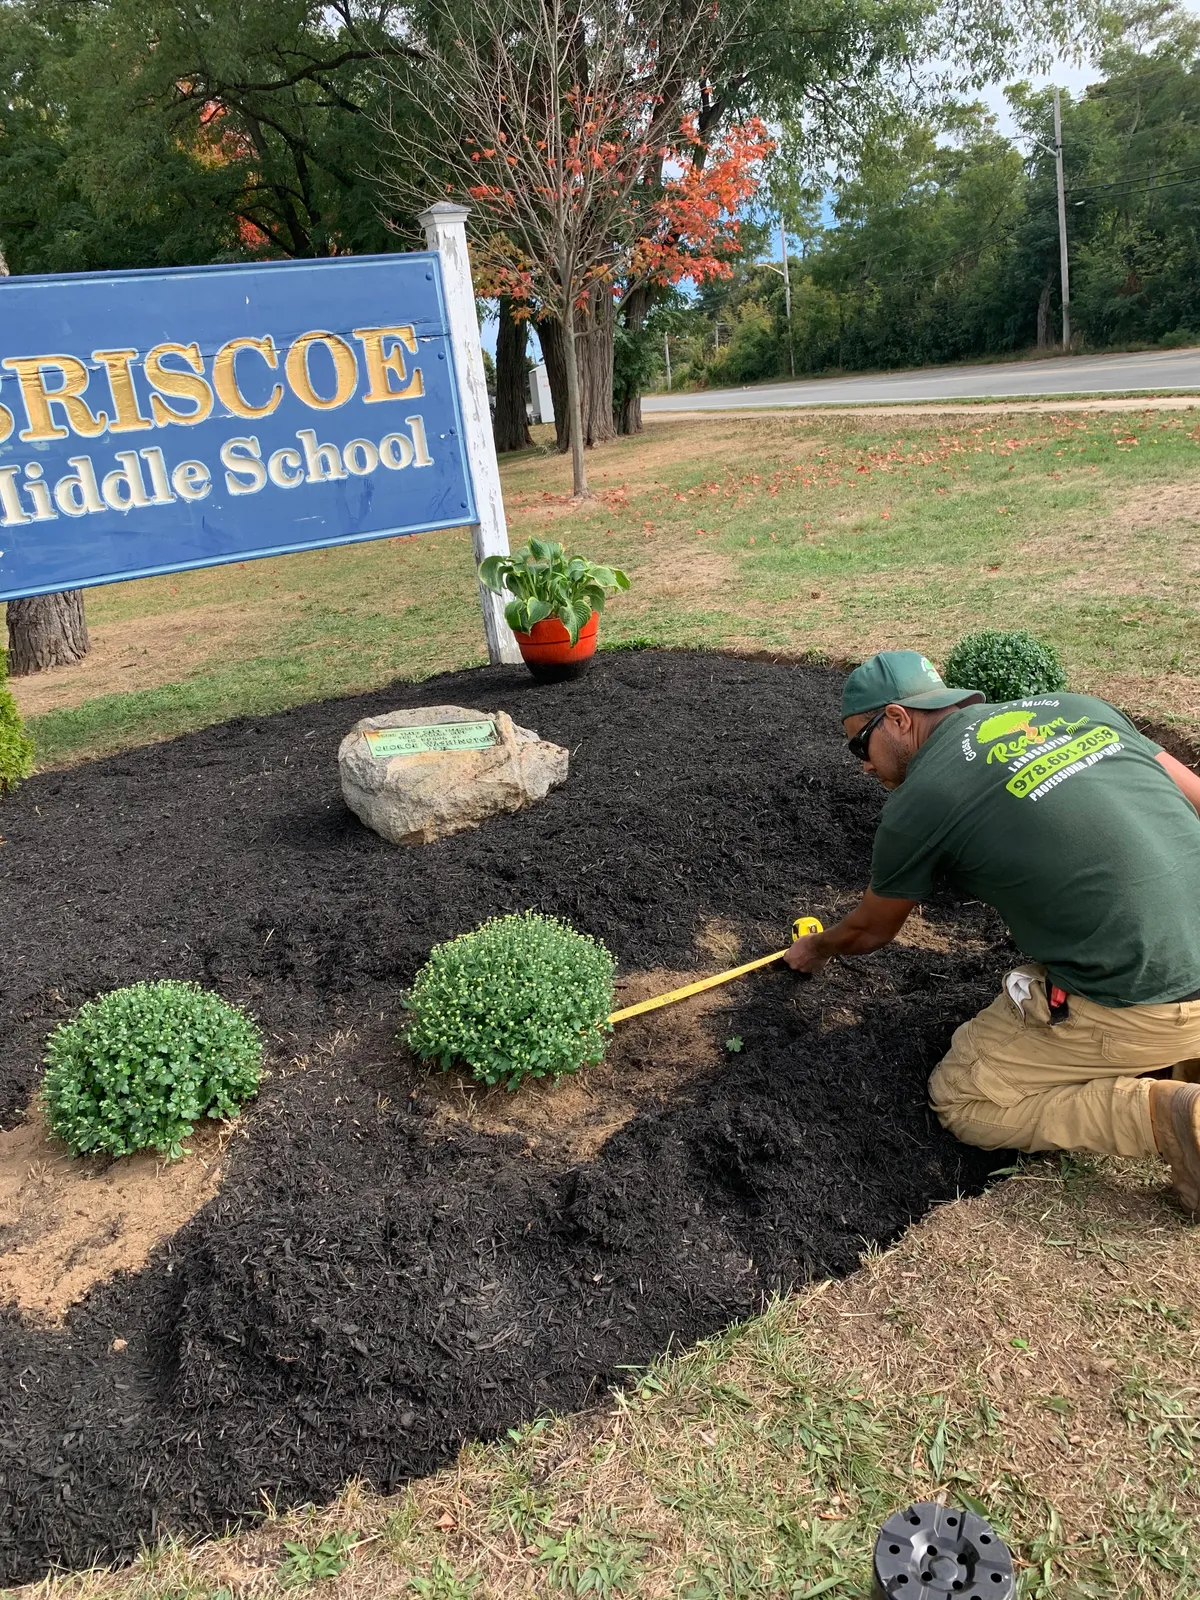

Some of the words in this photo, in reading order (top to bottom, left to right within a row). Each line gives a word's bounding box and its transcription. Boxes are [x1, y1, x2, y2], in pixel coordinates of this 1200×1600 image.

[0, 324, 425, 444] RISCOE
[220, 415, 434, 496] School
[1021, 699, 1060, 708] Mulch
[1013, 729, 1113, 791] 978.601.2058
[1029, 760, 1088, 802] PROFESSIONAL
[1085, 752, 1104, 767] AND
